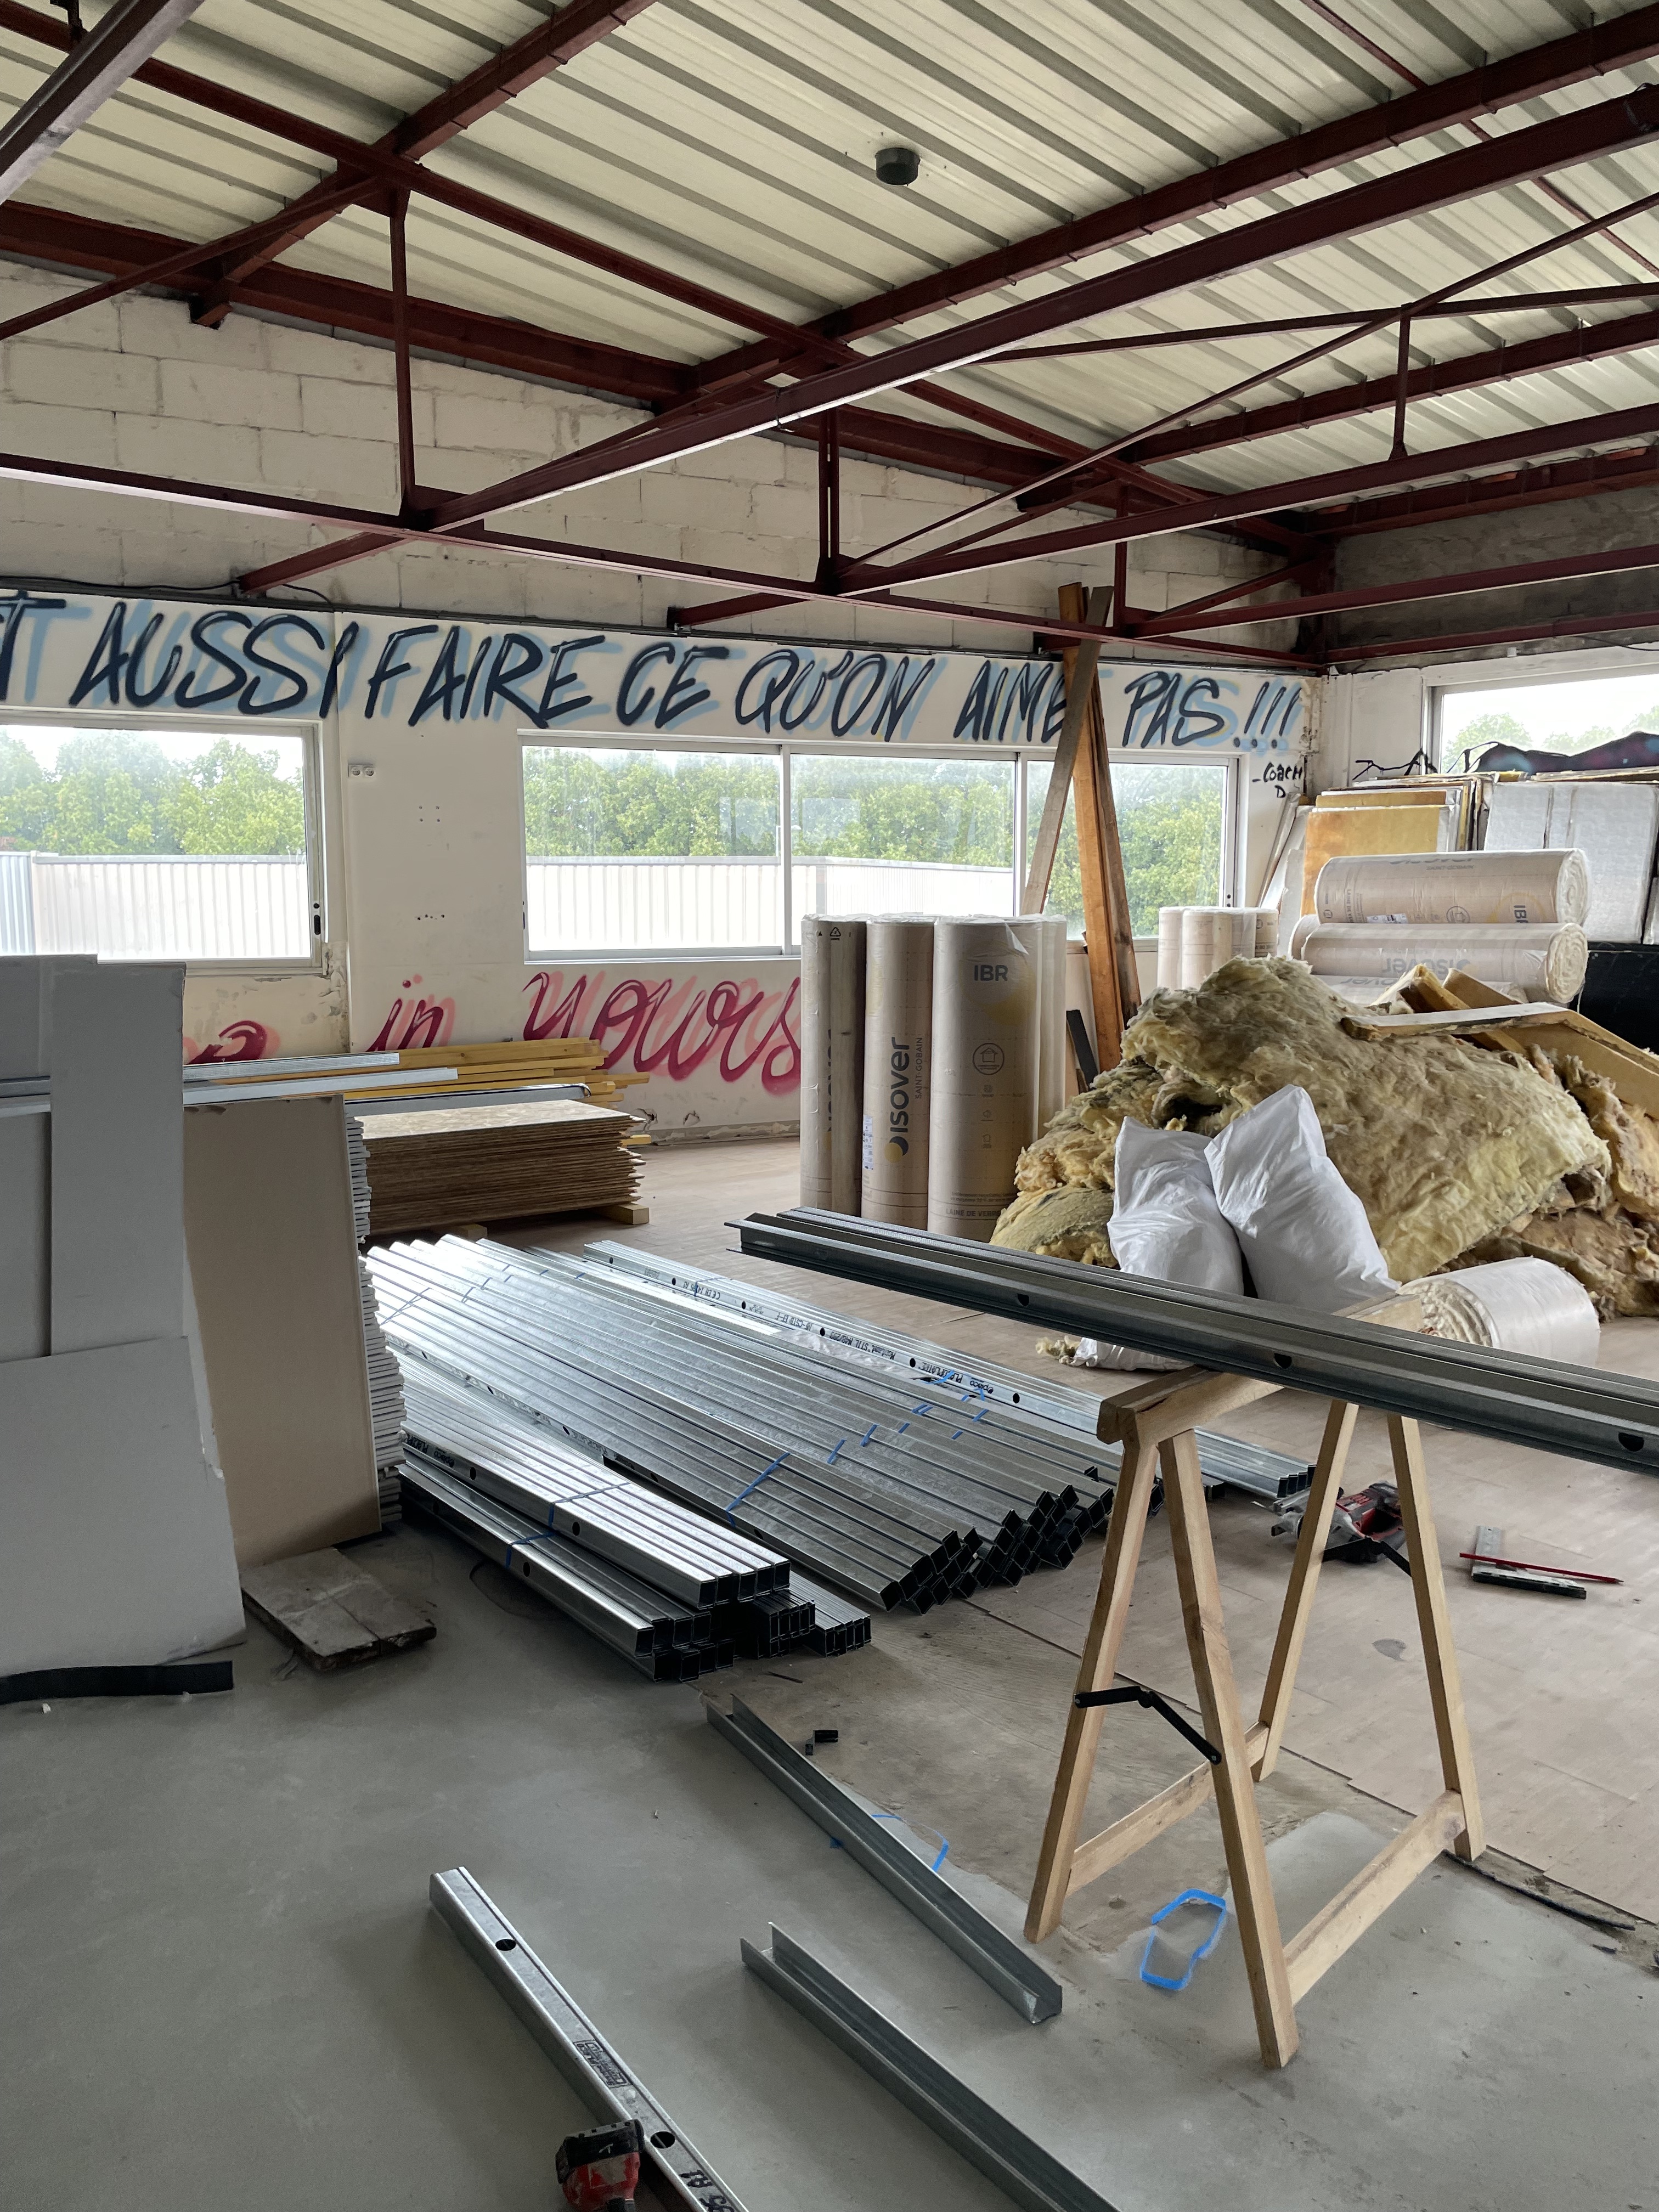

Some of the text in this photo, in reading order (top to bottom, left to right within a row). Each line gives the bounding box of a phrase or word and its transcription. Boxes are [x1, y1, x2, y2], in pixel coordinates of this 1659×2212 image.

[0, 589, 66, 702] T
[69, 601, 359, 718] AUSSI
[364, 624, 606, 729] FAIRE
[616, 641, 730, 729] CE
[973, 964, 1009, 982] IBR
[890, 1036, 910, 1133] isover
[915, 1037, 923, 1100] SAINT-GOBAIN
